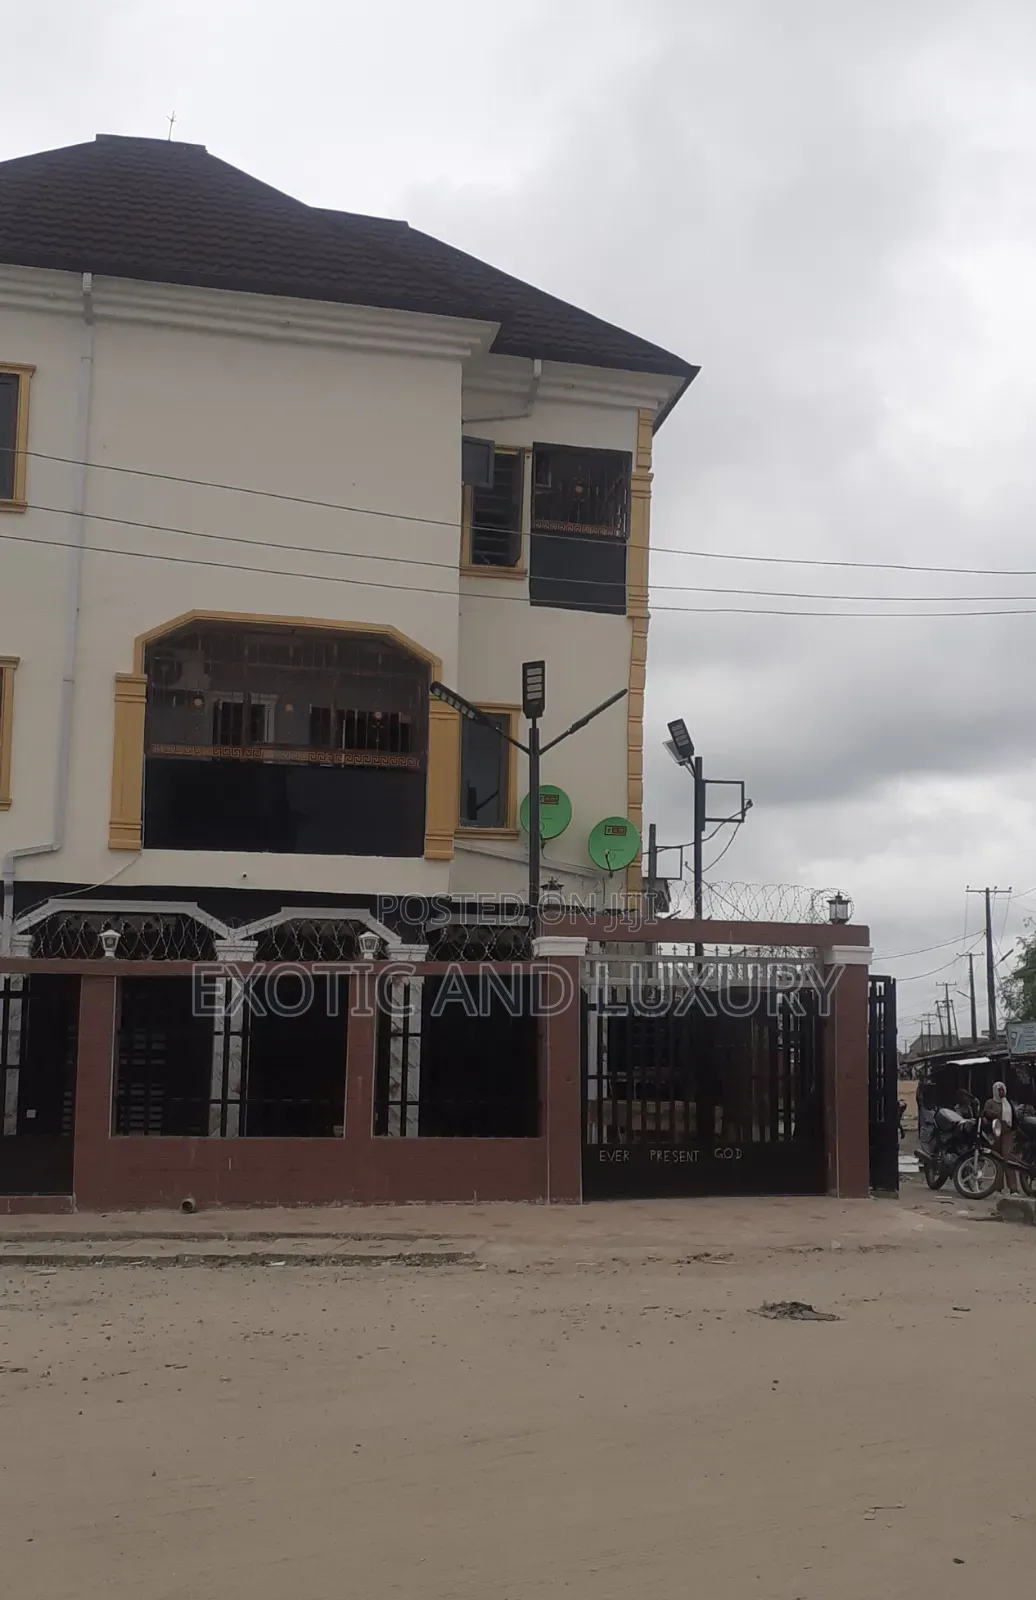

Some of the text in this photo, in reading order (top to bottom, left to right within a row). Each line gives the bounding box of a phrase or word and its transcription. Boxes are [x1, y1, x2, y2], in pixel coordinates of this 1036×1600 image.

[599, 1147, 743, 1163] EVER PRESENT GOD
